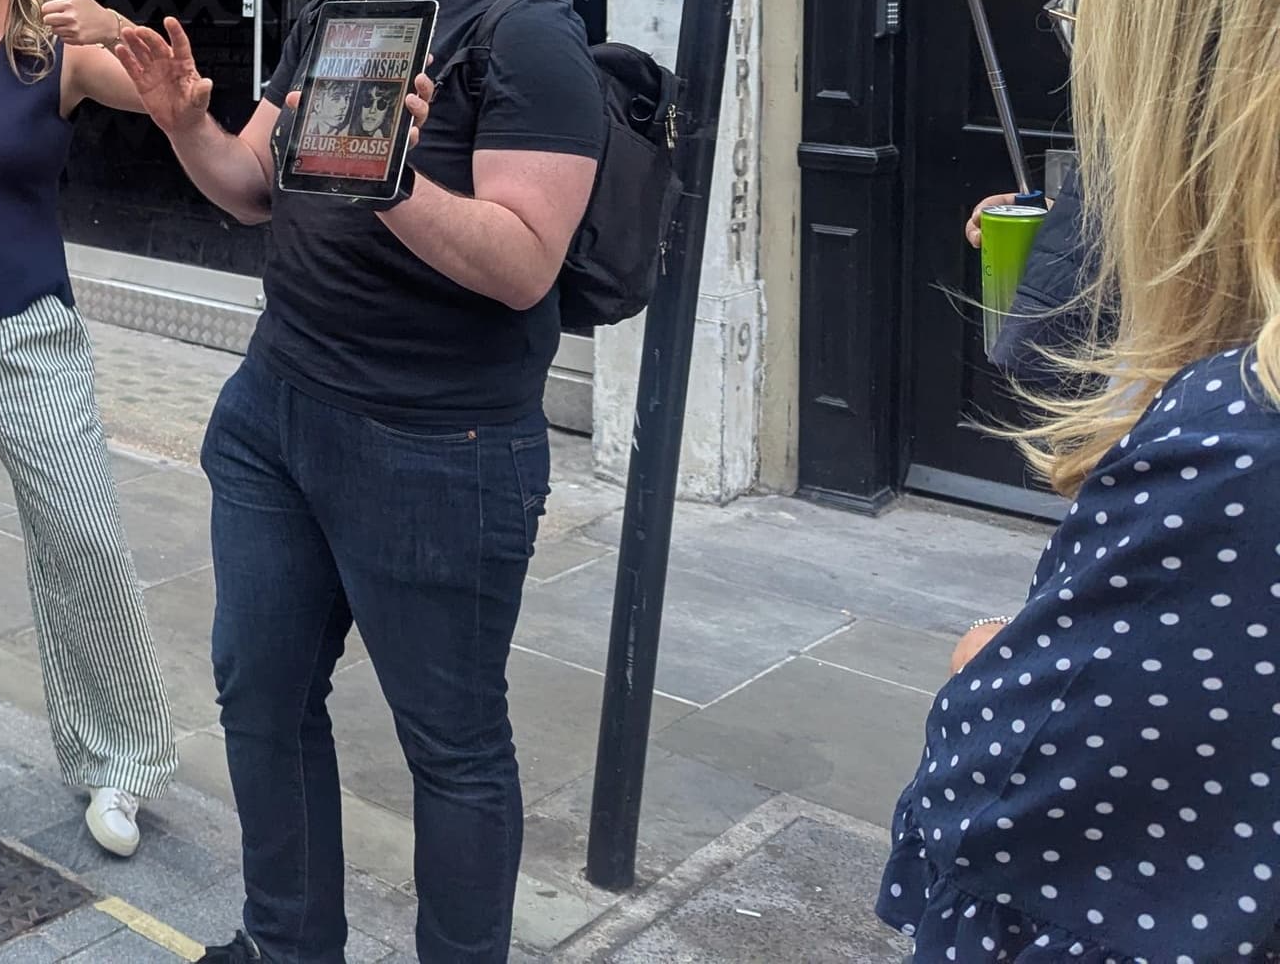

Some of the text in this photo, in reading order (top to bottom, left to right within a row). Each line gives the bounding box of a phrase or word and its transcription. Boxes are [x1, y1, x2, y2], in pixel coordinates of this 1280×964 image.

[324, 24, 374, 49] NME
[355, 50, 410, 60] HEAVYWEIGHT
[302, 136, 390, 155] BLUR OASIS
[730, 322, 751, 362] 19
